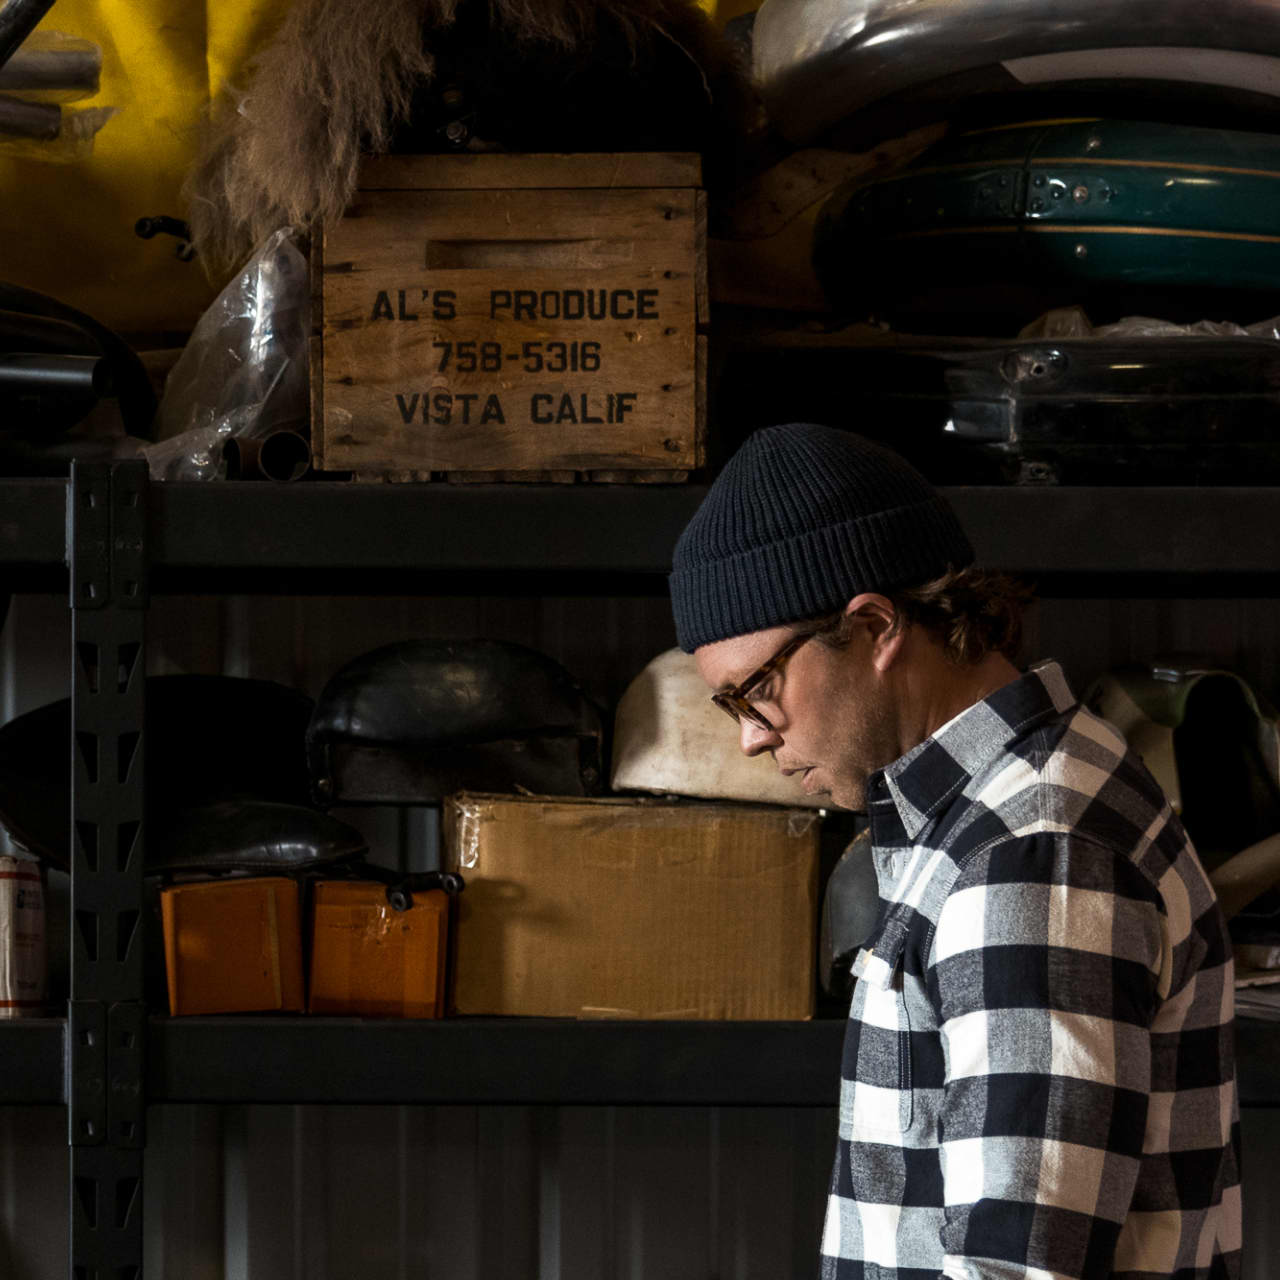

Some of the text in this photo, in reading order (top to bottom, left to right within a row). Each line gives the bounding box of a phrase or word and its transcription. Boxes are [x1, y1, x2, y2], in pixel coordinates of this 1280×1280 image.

[371, 288, 660, 321] AL'S PRODUCE
[432, 341, 601, 373] 758-5316
[396, 392, 638, 425] VISTA CALIF
